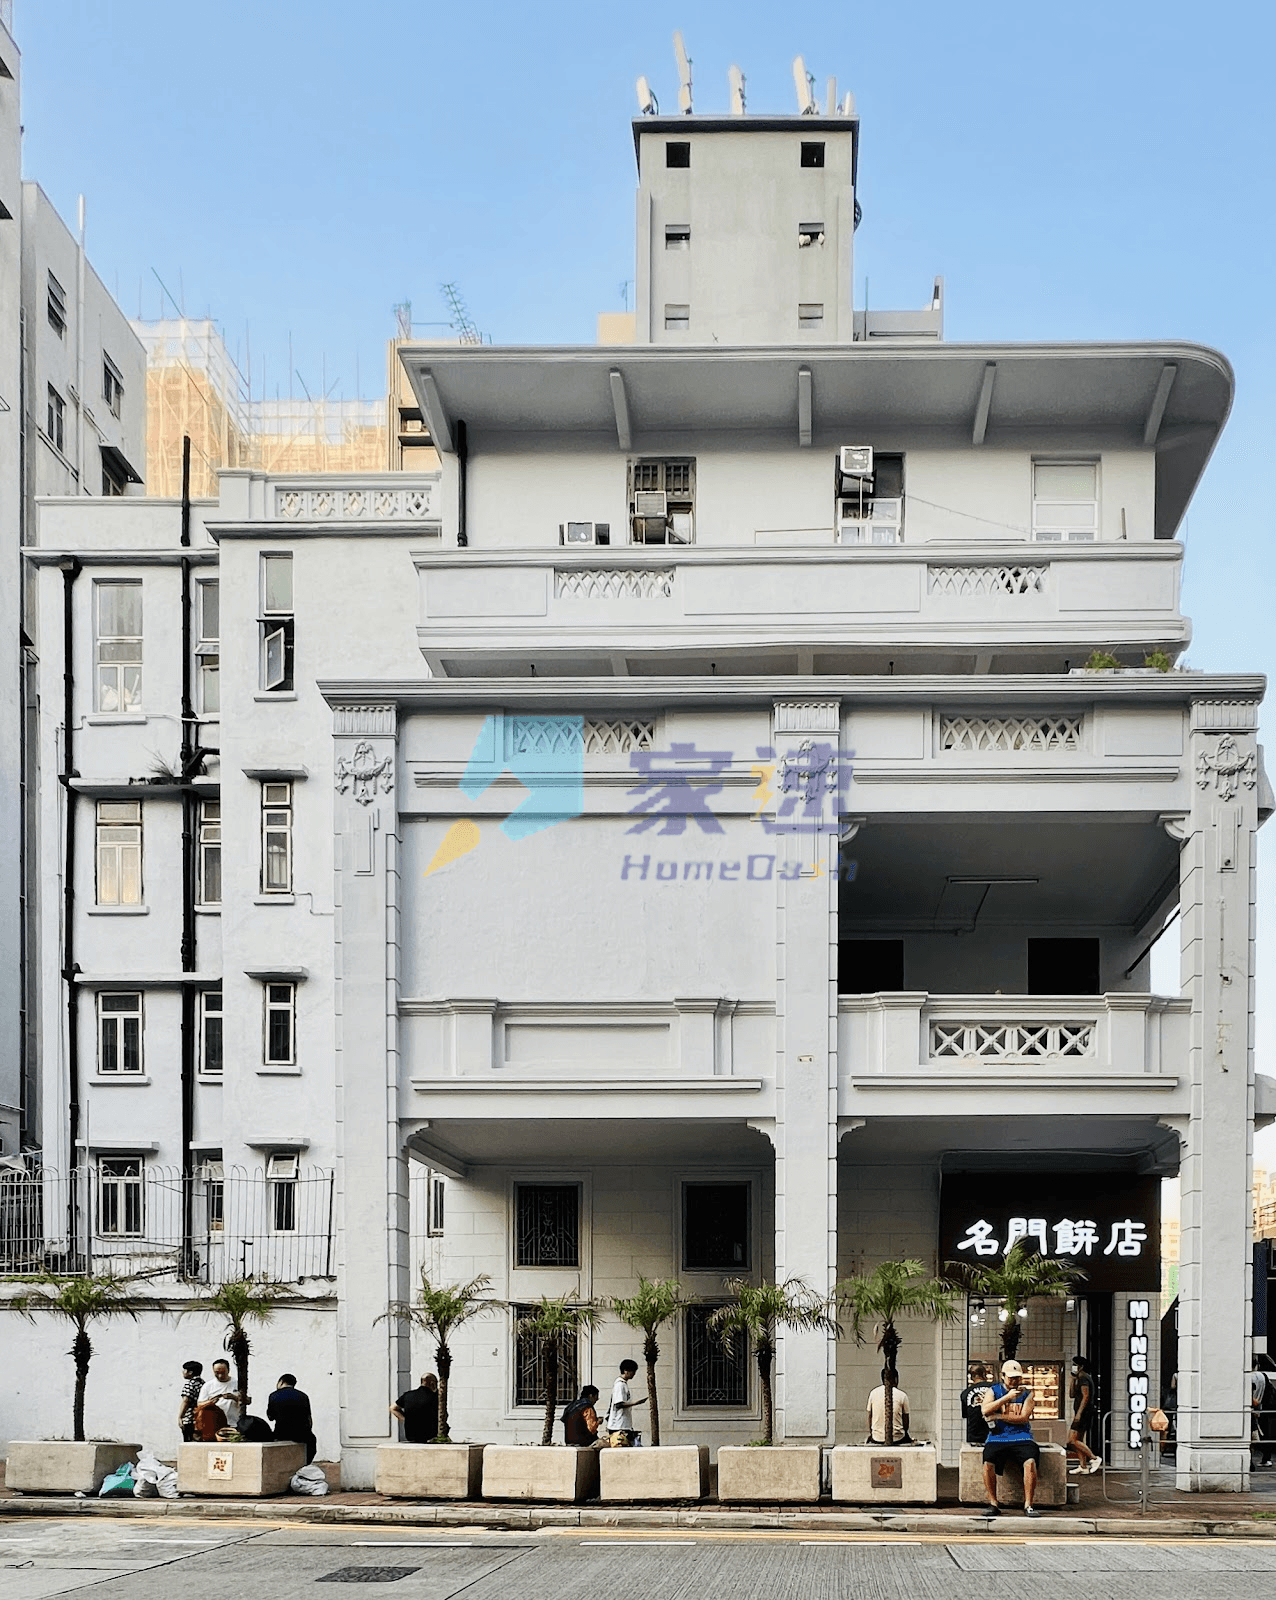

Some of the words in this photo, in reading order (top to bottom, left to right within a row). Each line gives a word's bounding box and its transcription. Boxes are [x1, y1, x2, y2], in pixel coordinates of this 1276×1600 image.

[957, 1217, 1148, 1256] 名門餅店
[1129, 1300, 1149, 1372] MING
